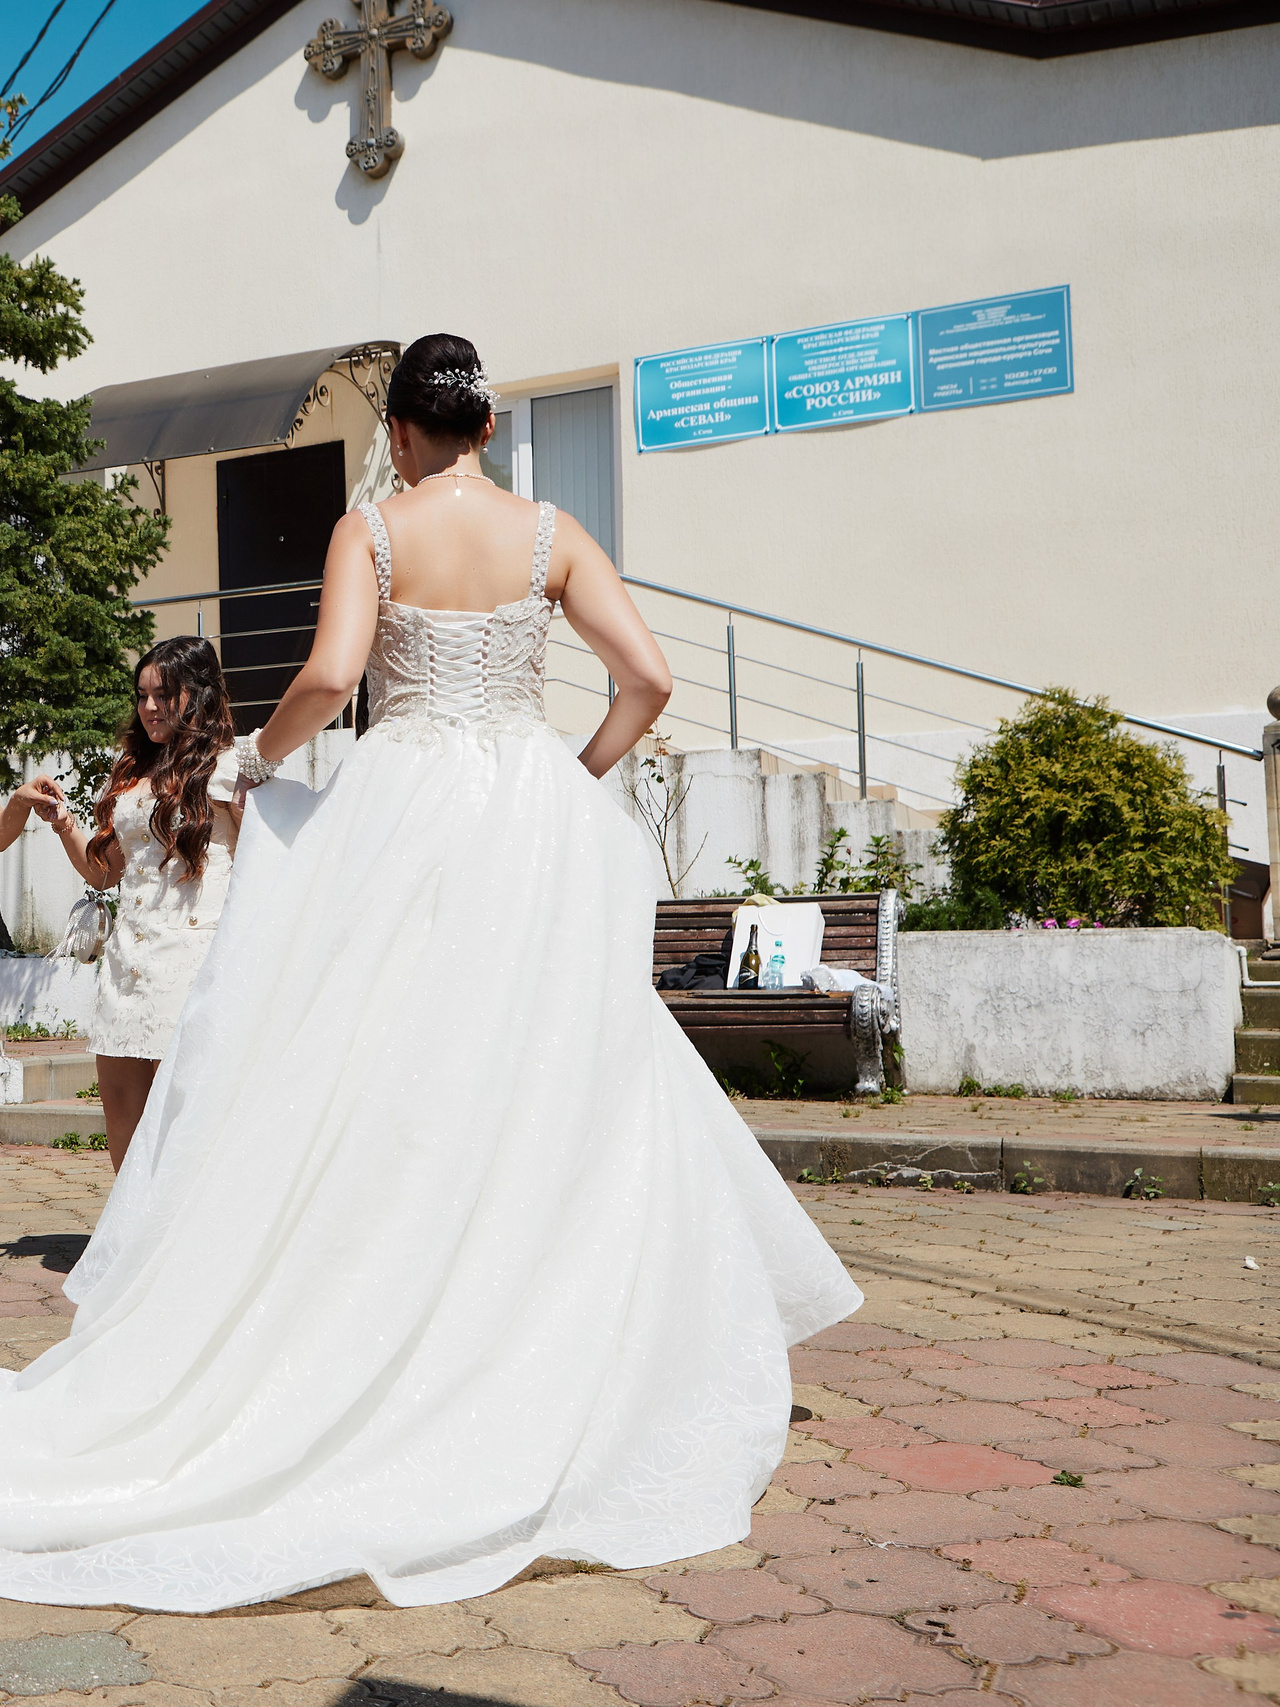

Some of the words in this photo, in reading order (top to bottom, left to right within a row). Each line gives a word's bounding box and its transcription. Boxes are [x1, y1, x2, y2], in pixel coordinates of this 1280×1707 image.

[669, 374, 733, 390] Общественная
[784, 379, 840, 399] «СОЮЗ
[843, 370, 902, 391] АРМЯН
[671, 385, 726, 401] организация
[805, 388, 881, 411] РОССИИ»
[647, 401, 711, 421] Армянская
[713, 395, 759, 408] община
[674, 411, 732, 428] «СЕВАН»
